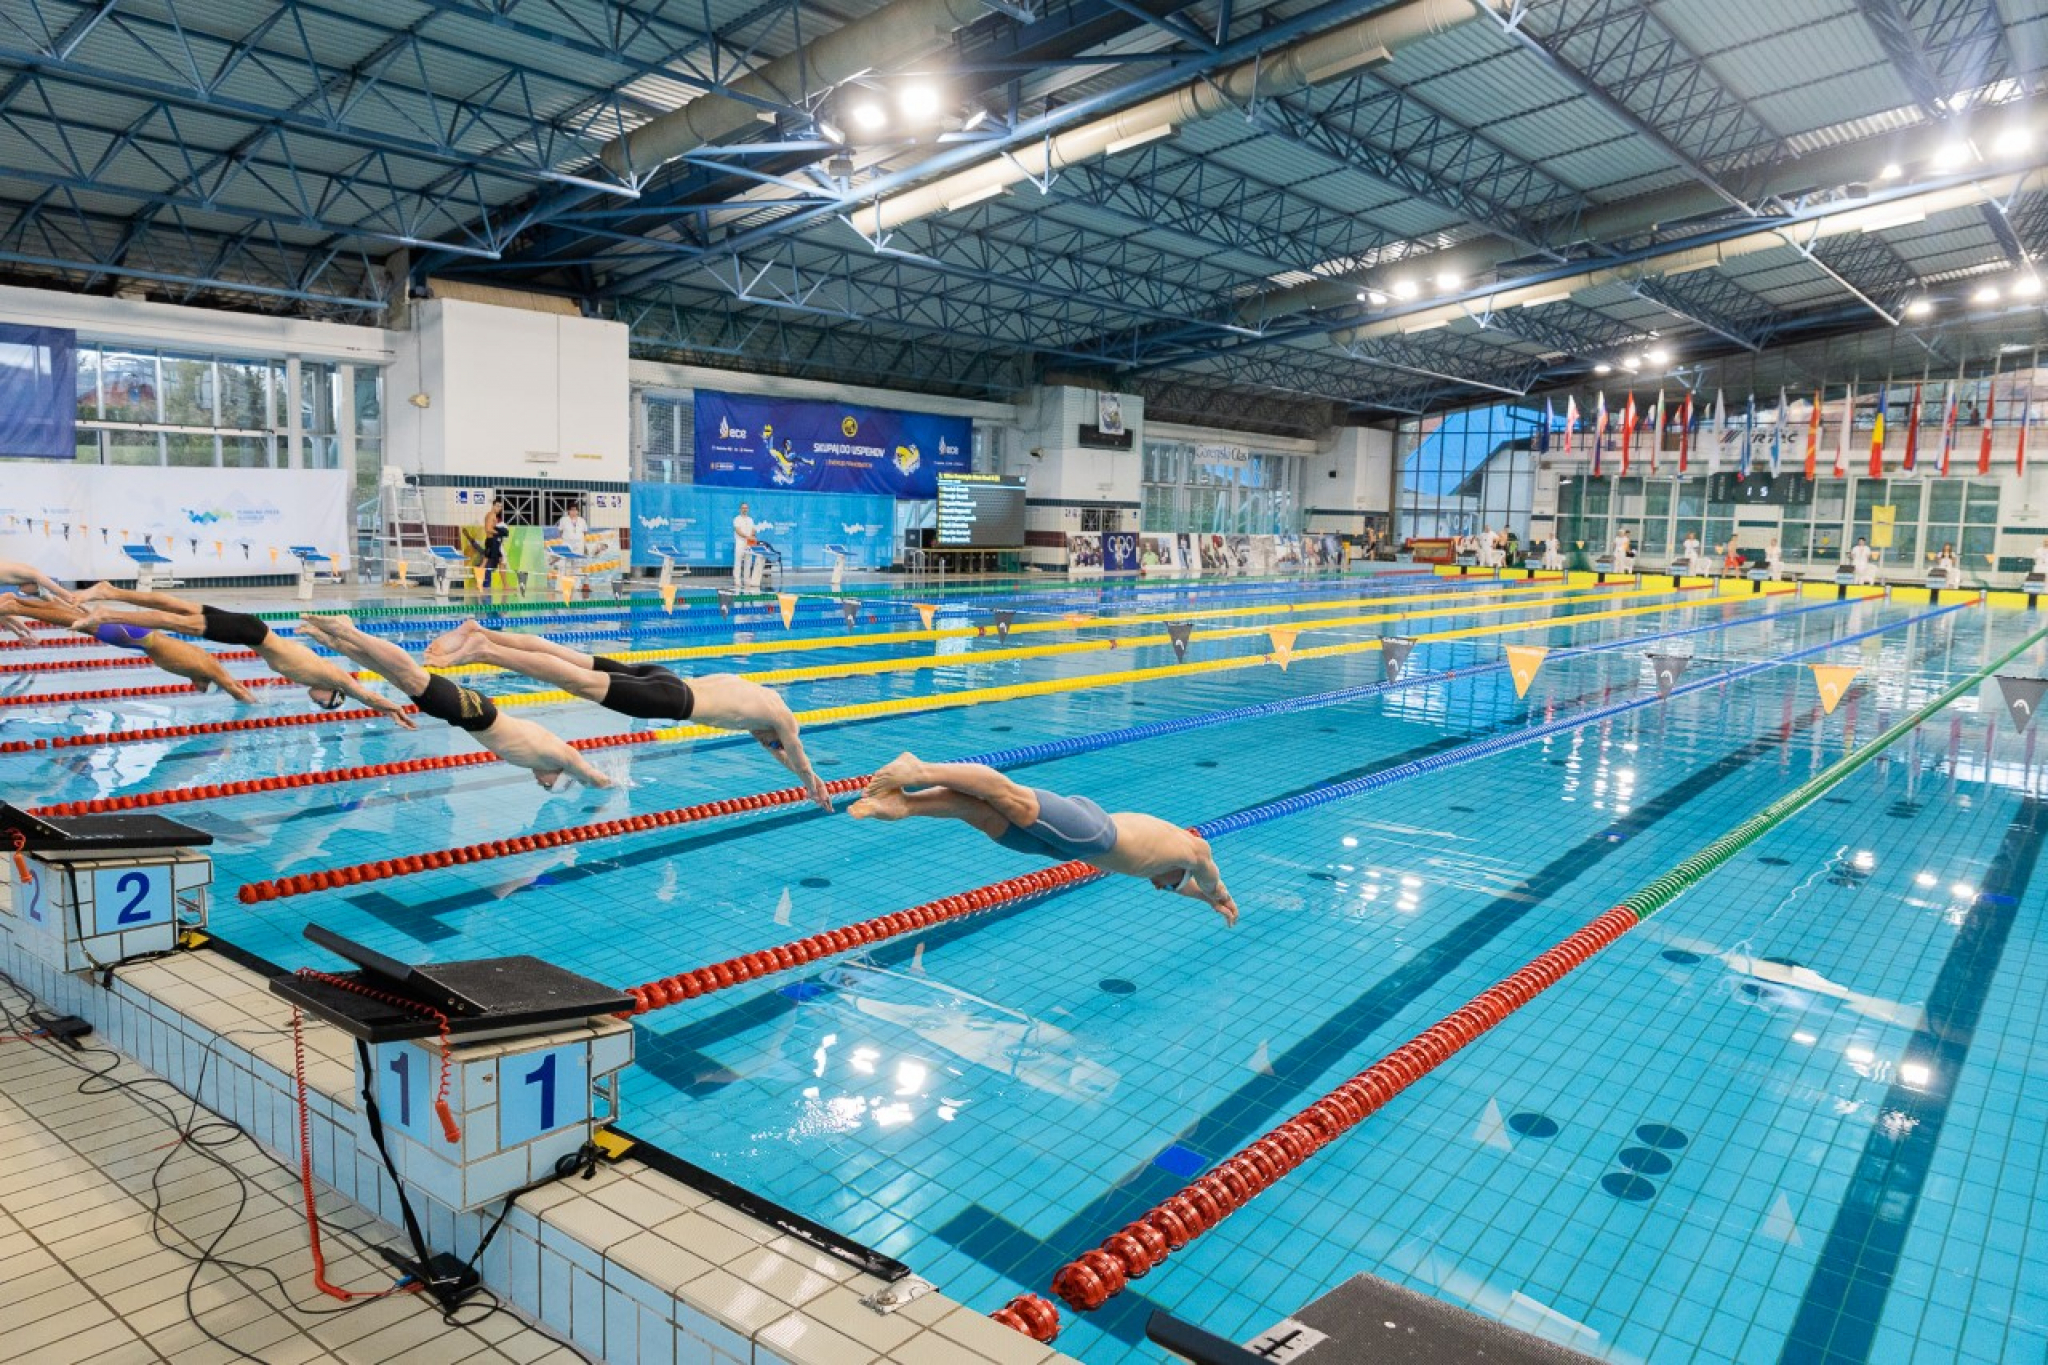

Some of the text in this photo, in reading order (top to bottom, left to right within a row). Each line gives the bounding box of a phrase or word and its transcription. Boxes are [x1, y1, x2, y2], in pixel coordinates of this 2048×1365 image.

[28, 868, 42, 923] 2
[116, 871, 152, 926] 2
[390, 1051, 410, 1128] 1
[525, 1053, 556, 1131] 1
